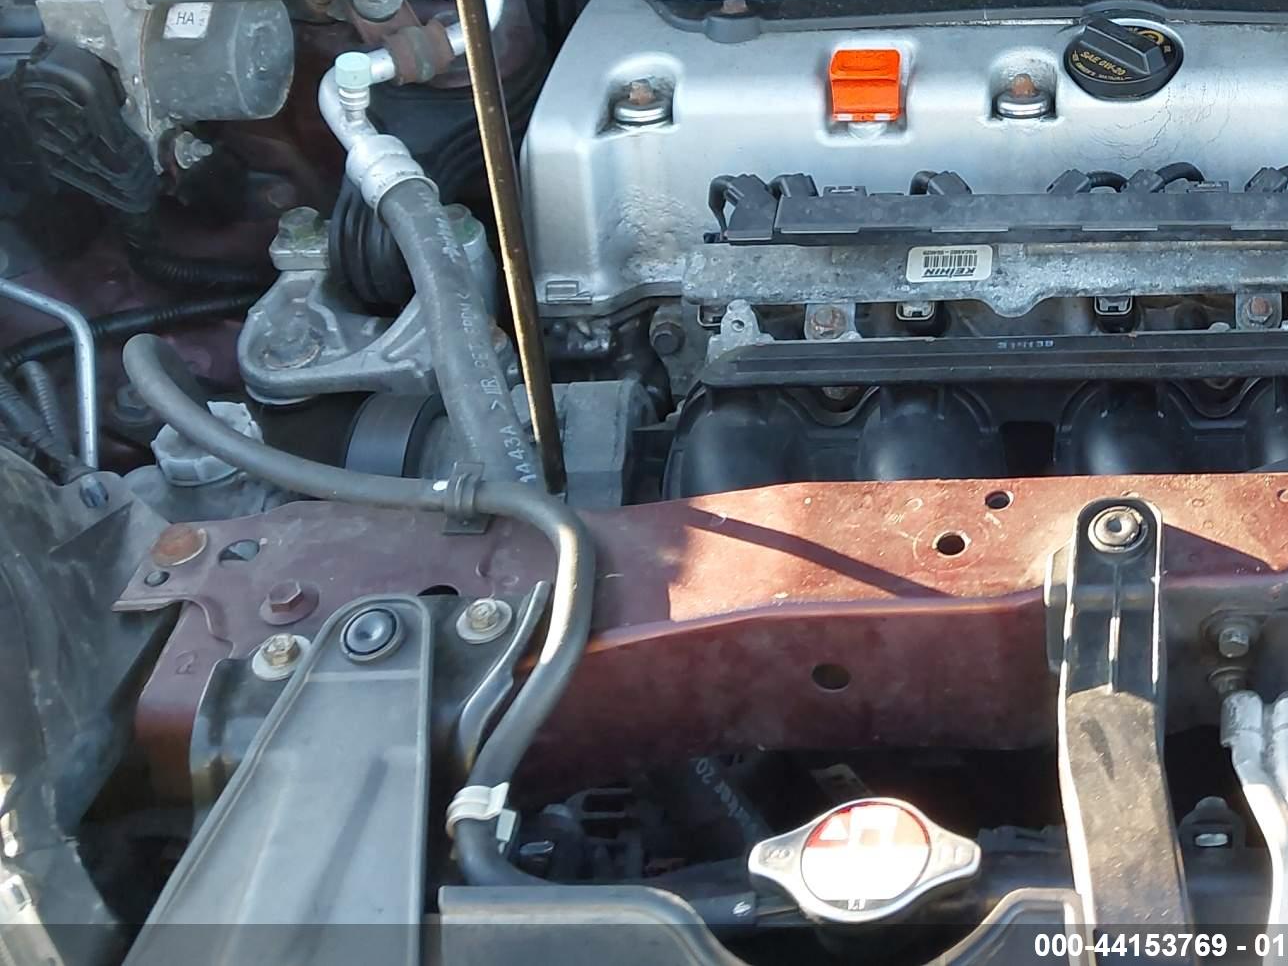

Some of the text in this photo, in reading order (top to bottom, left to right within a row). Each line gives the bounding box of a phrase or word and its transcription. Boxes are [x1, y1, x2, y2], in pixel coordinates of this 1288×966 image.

[176, 12, 194, 25] HA
[1080, 51, 1101, 65] SAE
[923, 267, 977, 278] KEIHIN
